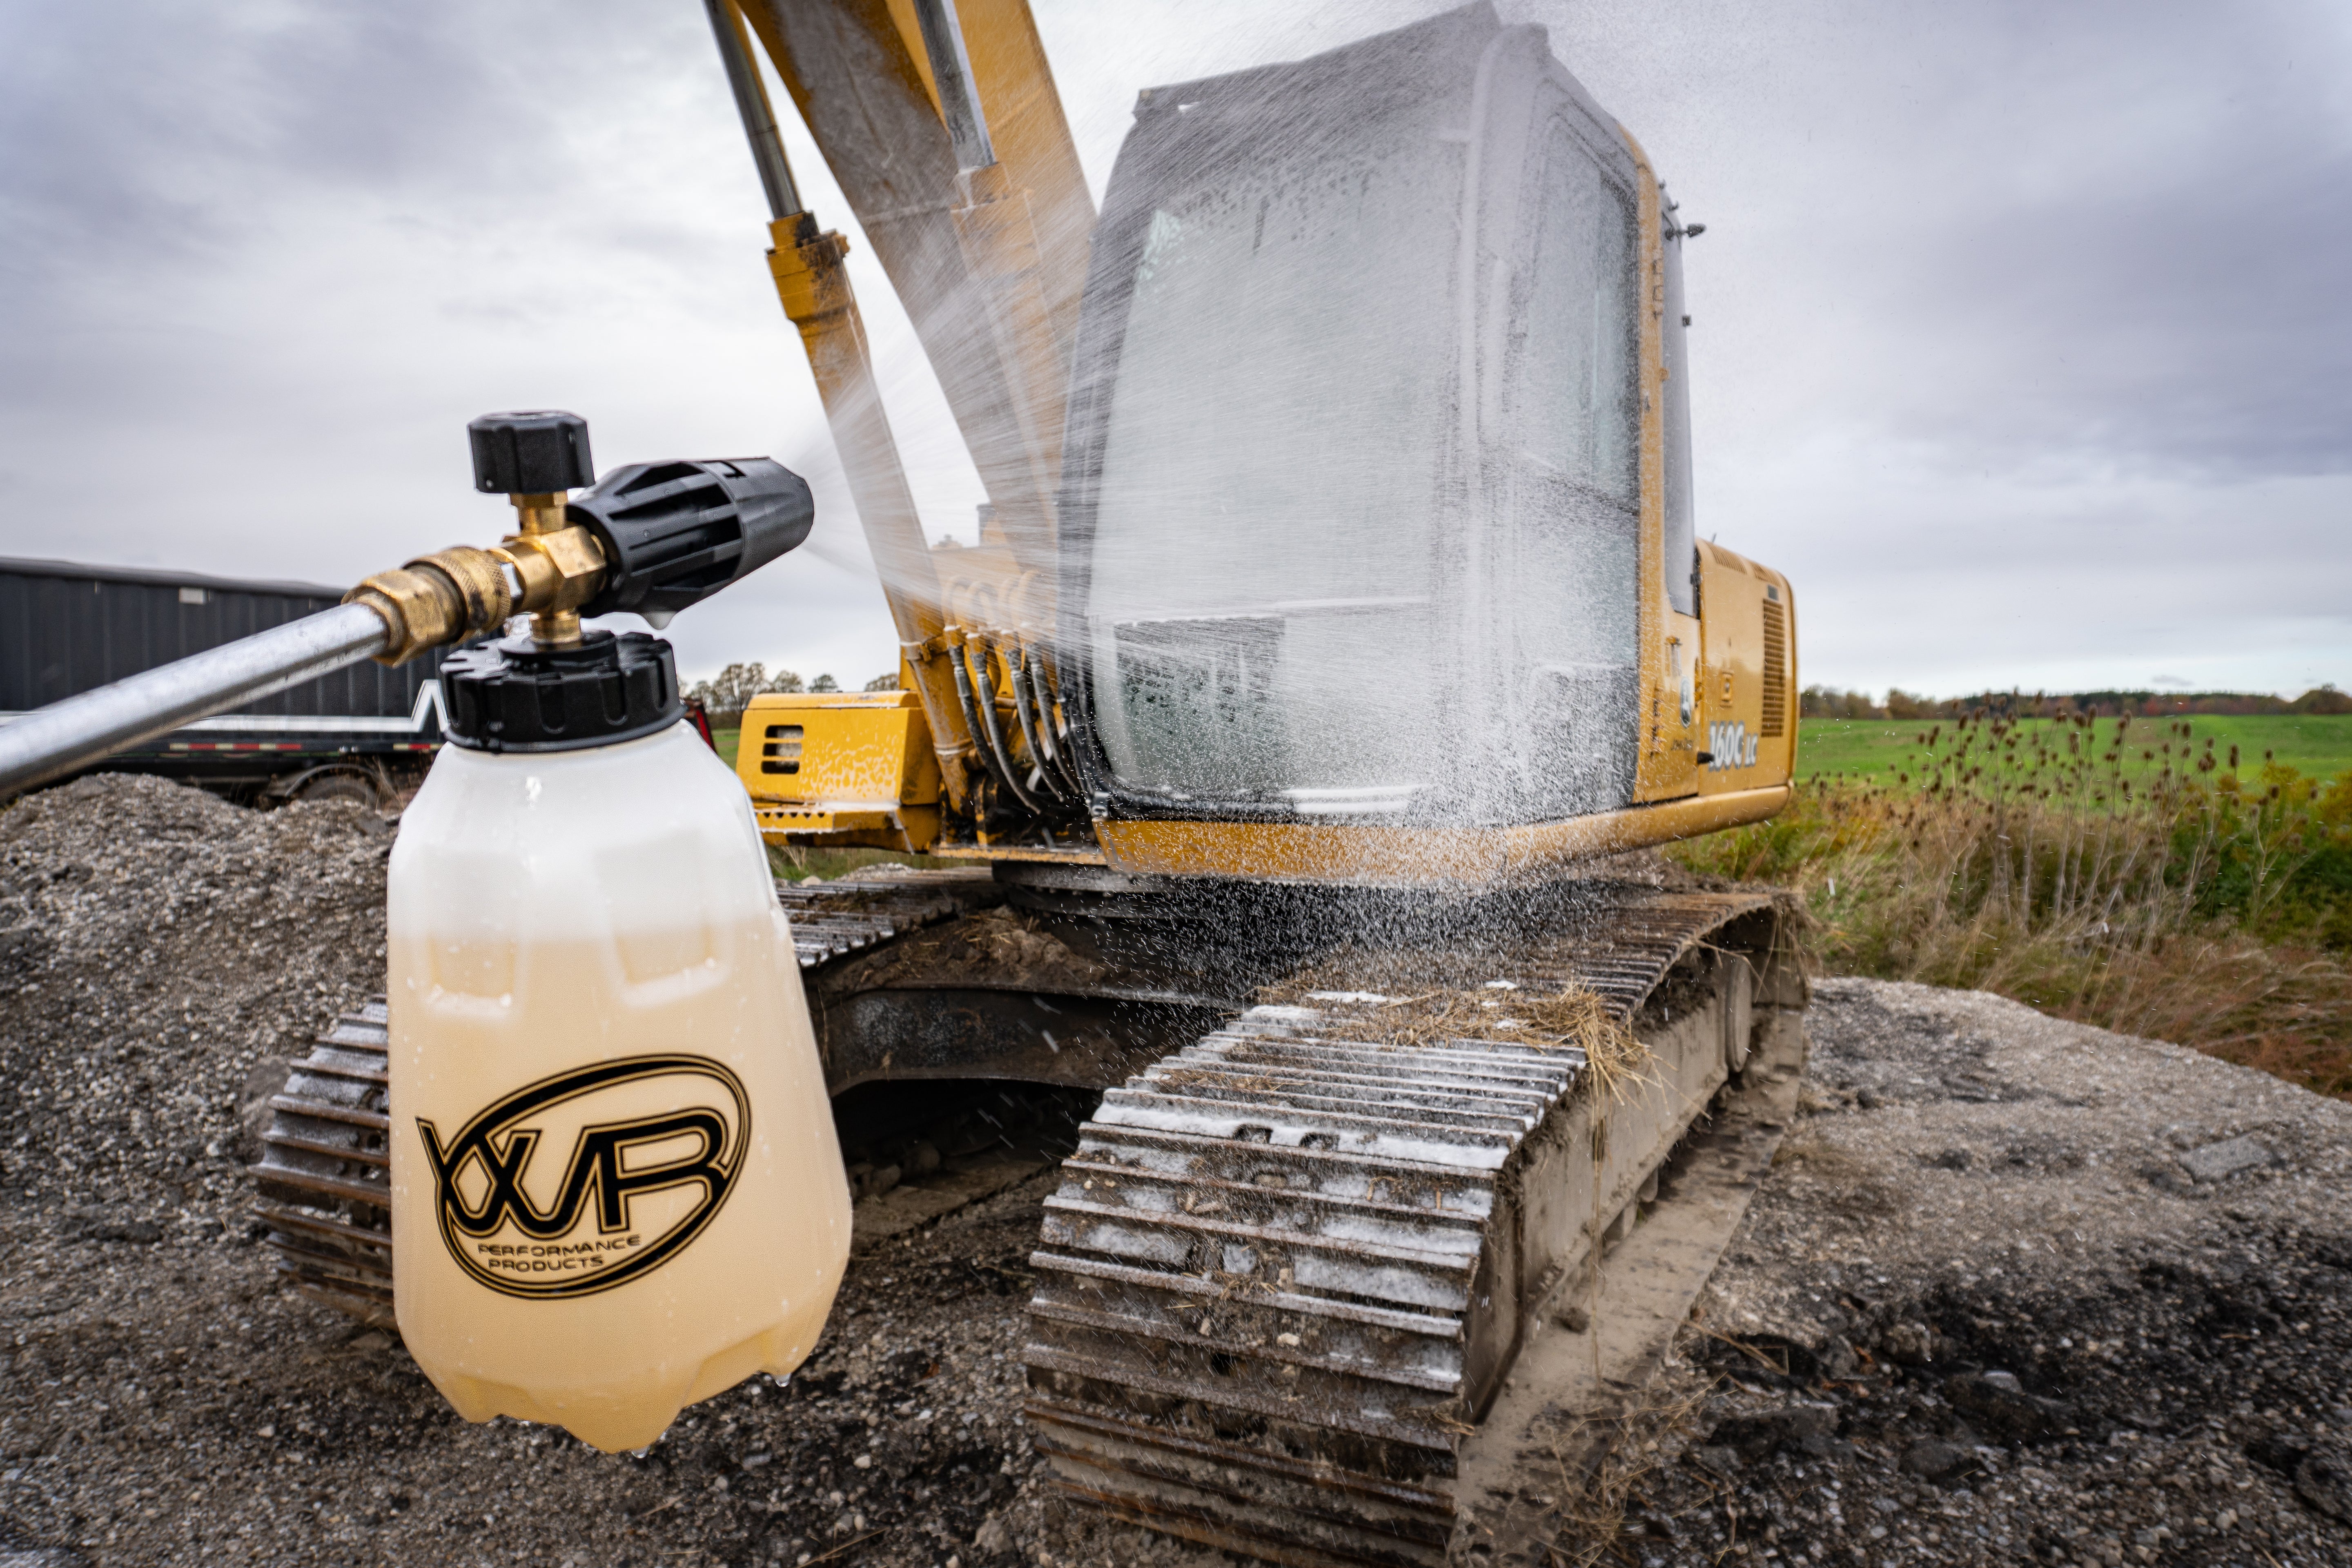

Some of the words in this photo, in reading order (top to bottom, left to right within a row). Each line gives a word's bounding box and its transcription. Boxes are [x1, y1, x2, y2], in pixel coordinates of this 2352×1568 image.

[1708, 720, 1745, 773] 160C
[1744, 733, 1758, 768] LC
[478, 1234, 640, 1256] PERFORMANCE
[488, 1254, 603, 1272] PRODUCTS
